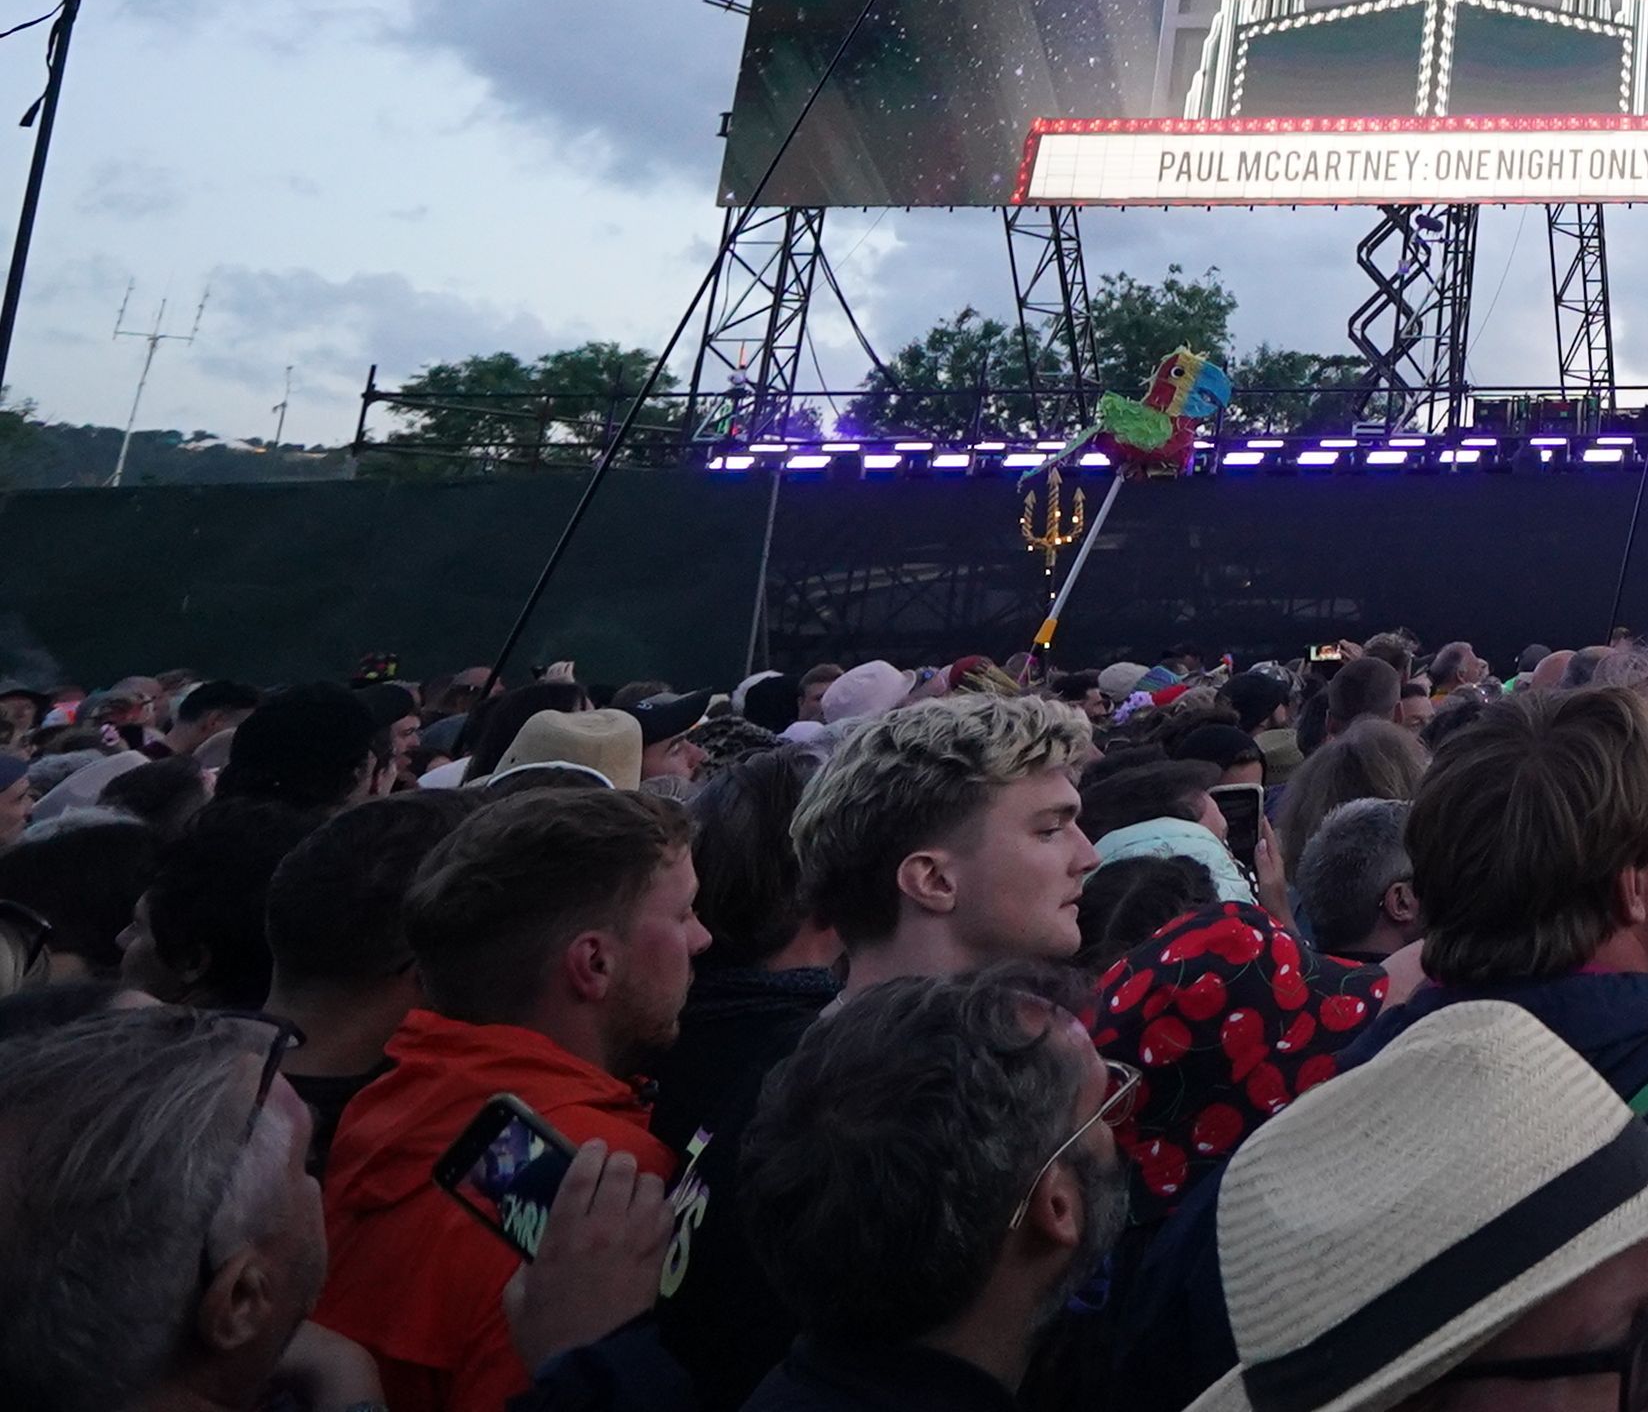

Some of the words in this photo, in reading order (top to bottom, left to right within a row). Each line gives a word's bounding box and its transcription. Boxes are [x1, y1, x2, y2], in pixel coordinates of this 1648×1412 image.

[1157, 150, 1230, 182] PAUL
[1435, 150, 1490, 181] ONE
[1497, 149, 1583, 181] NIGHT
